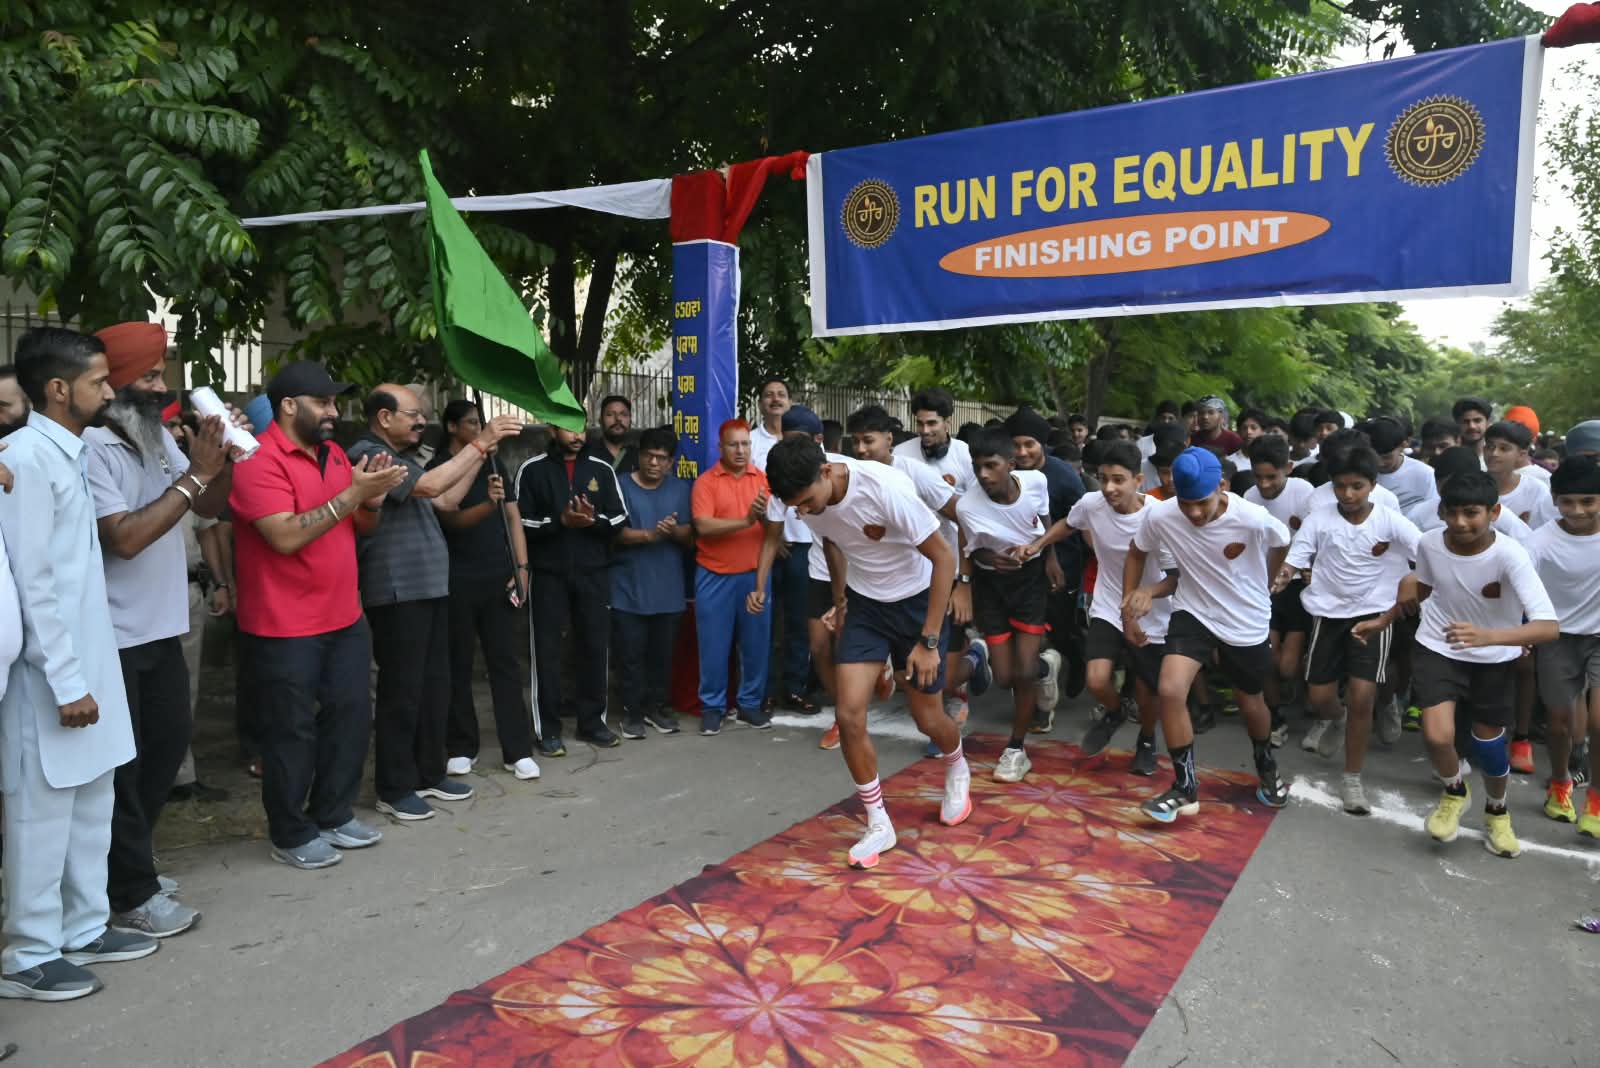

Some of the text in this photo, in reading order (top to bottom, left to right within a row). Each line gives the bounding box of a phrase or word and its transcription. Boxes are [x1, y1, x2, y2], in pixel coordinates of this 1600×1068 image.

[914, 175, 997, 228] RUN
[1012, 162, 1098, 217] FOR
[1113, 123, 1375, 202] EQUALITY
[974, 217, 1289, 272] FINISHING POINT
